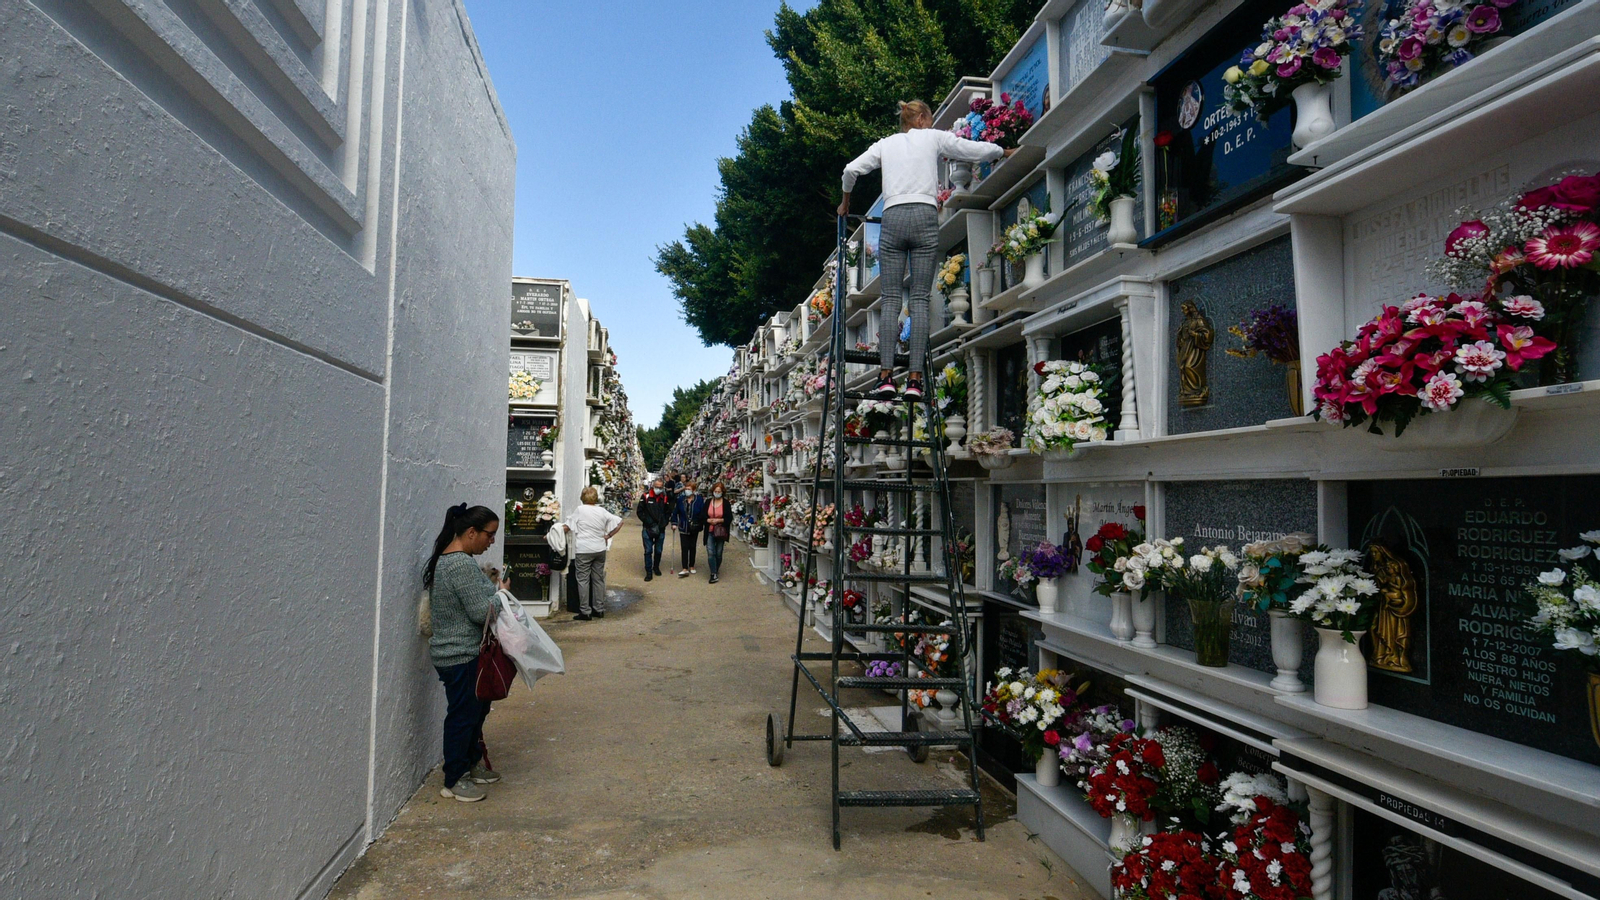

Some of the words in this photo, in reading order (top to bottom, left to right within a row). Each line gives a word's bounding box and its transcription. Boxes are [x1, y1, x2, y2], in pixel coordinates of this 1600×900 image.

[1203, 106, 1231, 130] ORTE
[1224, 141, 1234, 155] D.
[1235, 134, 1245, 149] E.
[1246, 127, 1256, 142] P.
[1464, 510, 1548, 526] EDUARDO
[1194, 522, 1235, 540] Antonio
[1457, 527, 1558, 545] RODRIGUEZ
[1457, 544, 1558, 564] RODRIGUEZ
[1461, 572, 1469, 582] A
[1473, 573, 1496, 585] LOS
[1500, 575, 1515, 586] 65
[1483, 562, 1540, 576] 13-1-1990
[1448, 582, 1499, 602] MARIA
[1458, 618, 1536, 643] RODRIGU
[1483, 638, 1542, 657] 7-12-2007
[1462, 647, 1470, 656] A
[1473, 649, 1497, 661] LOS
[1501, 653, 1517, 665] 88
[1521, 657, 1557, 673] AÑOS
[1465, 658, 1518, 678] VUESTRO
[1522, 671, 1554, 687] HIJO,
[1468, 671, 1505, 688] NUERA,
[1509, 680, 1550, 697] NIETOS
[1480, 684, 1487, 695] Y
[1492, 687, 1536, 707] FAMILIA
[1463, 693, 1480, 705] NO
[1484, 698, 1501, 710] OS
[1505, 703, 1556, 724] OLVIDAN
